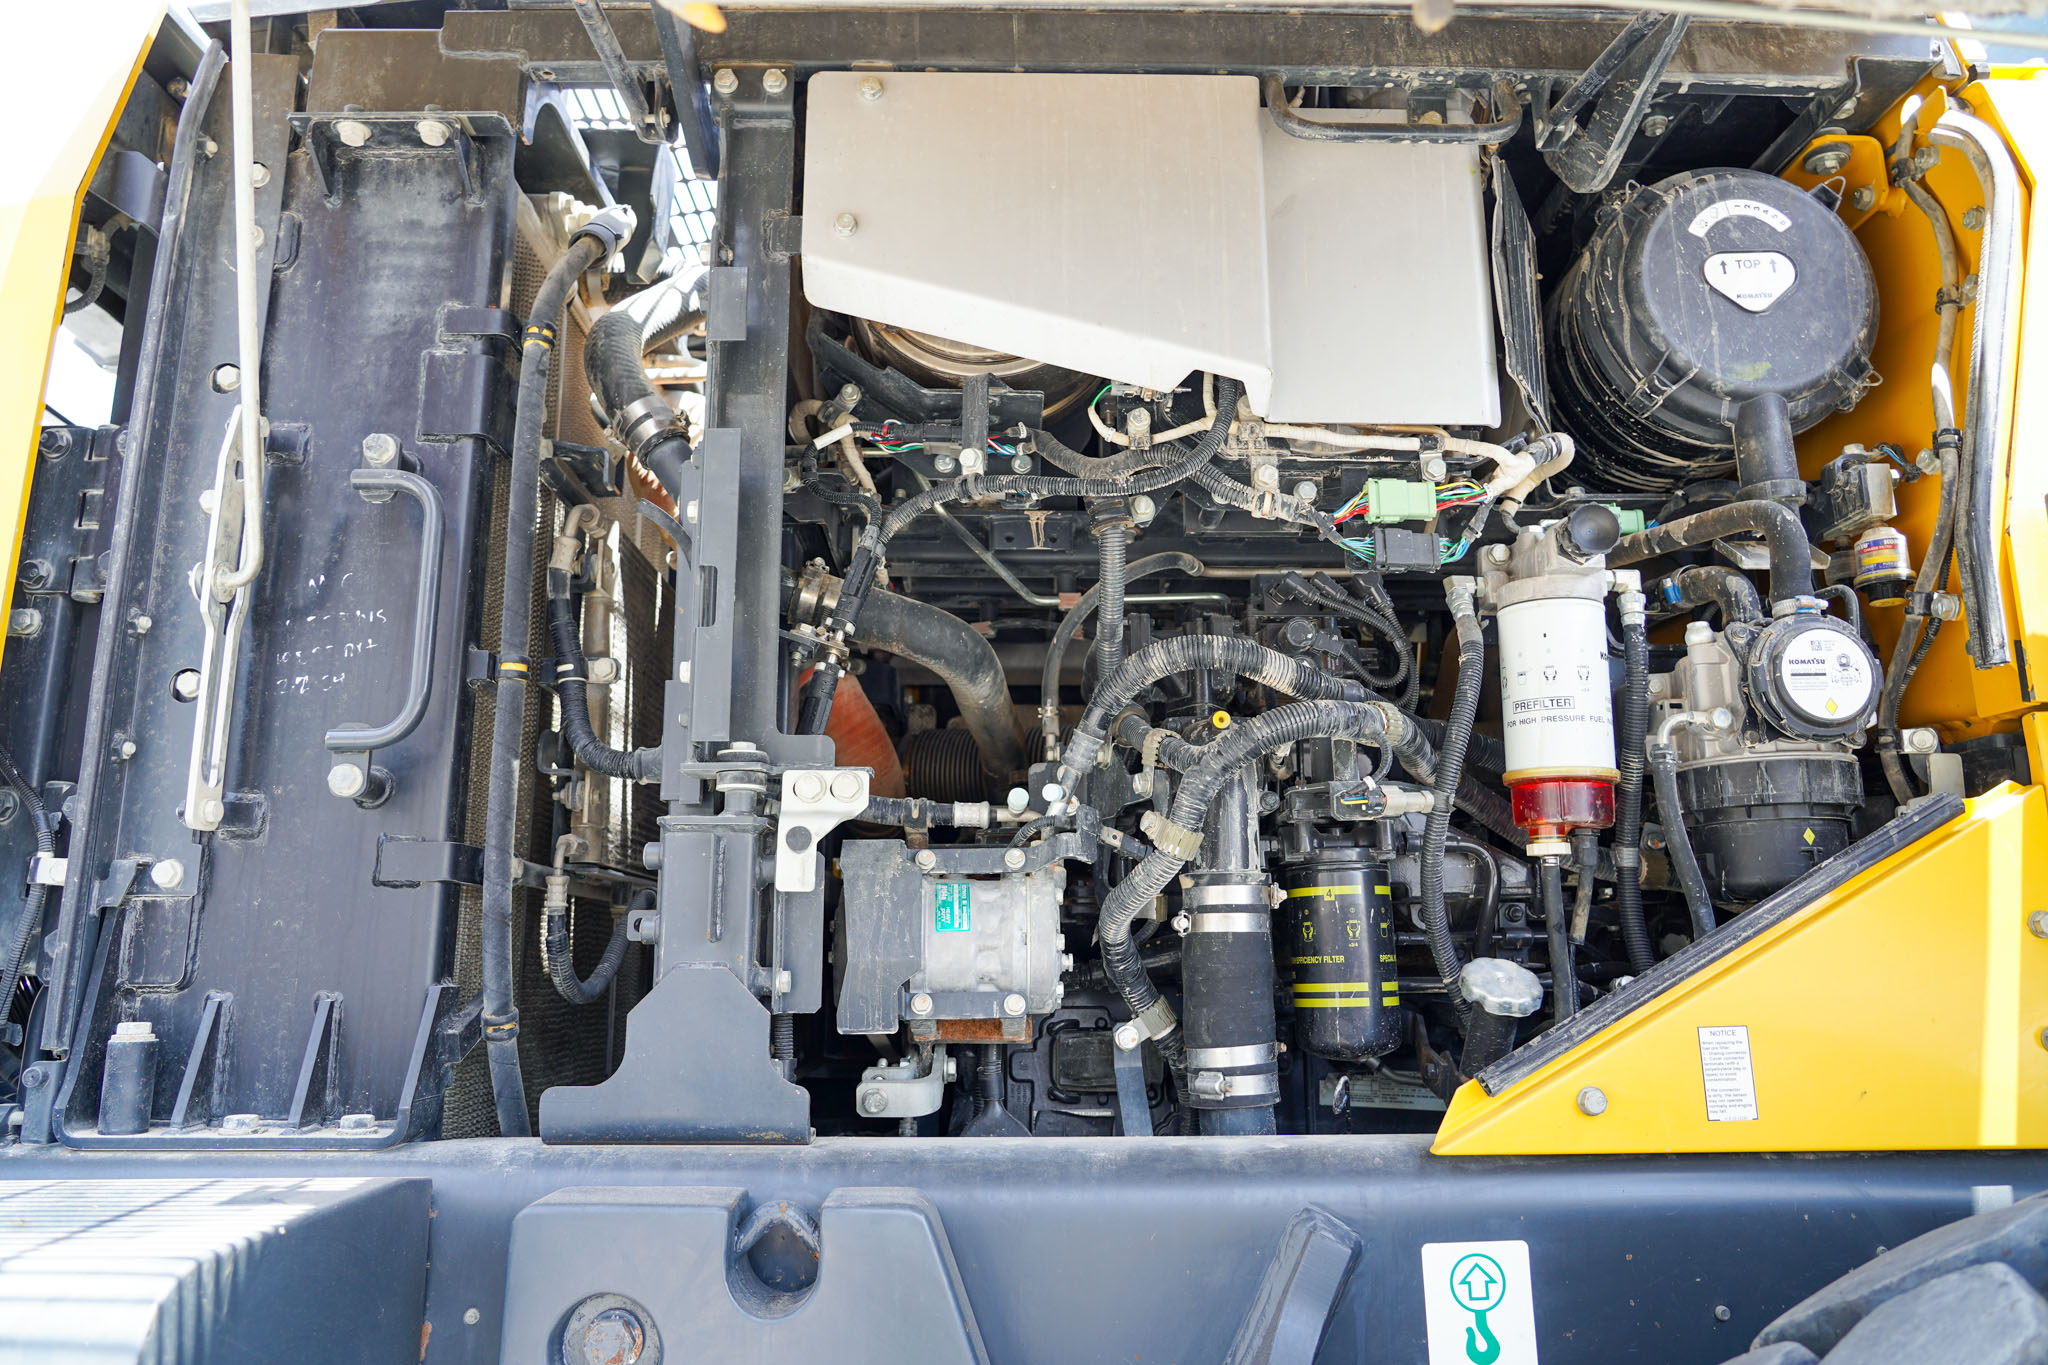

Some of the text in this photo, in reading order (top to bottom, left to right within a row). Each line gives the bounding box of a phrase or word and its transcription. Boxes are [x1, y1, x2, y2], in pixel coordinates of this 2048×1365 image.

[1735, 260, 1761, 269] TOP
[1788, 657, 1826, 665] KOMATSU
[1514, 698, 1571, 712] PREFILTER
[1506, 719, 1517, 728] FOR
[1519, 717, 1537, 726] HIGH
[1541, 715, 1586, 723] PRESSURE
[1326, 888, 1333, 898] 4
[1323, 955, 1345, 964] FILTER
